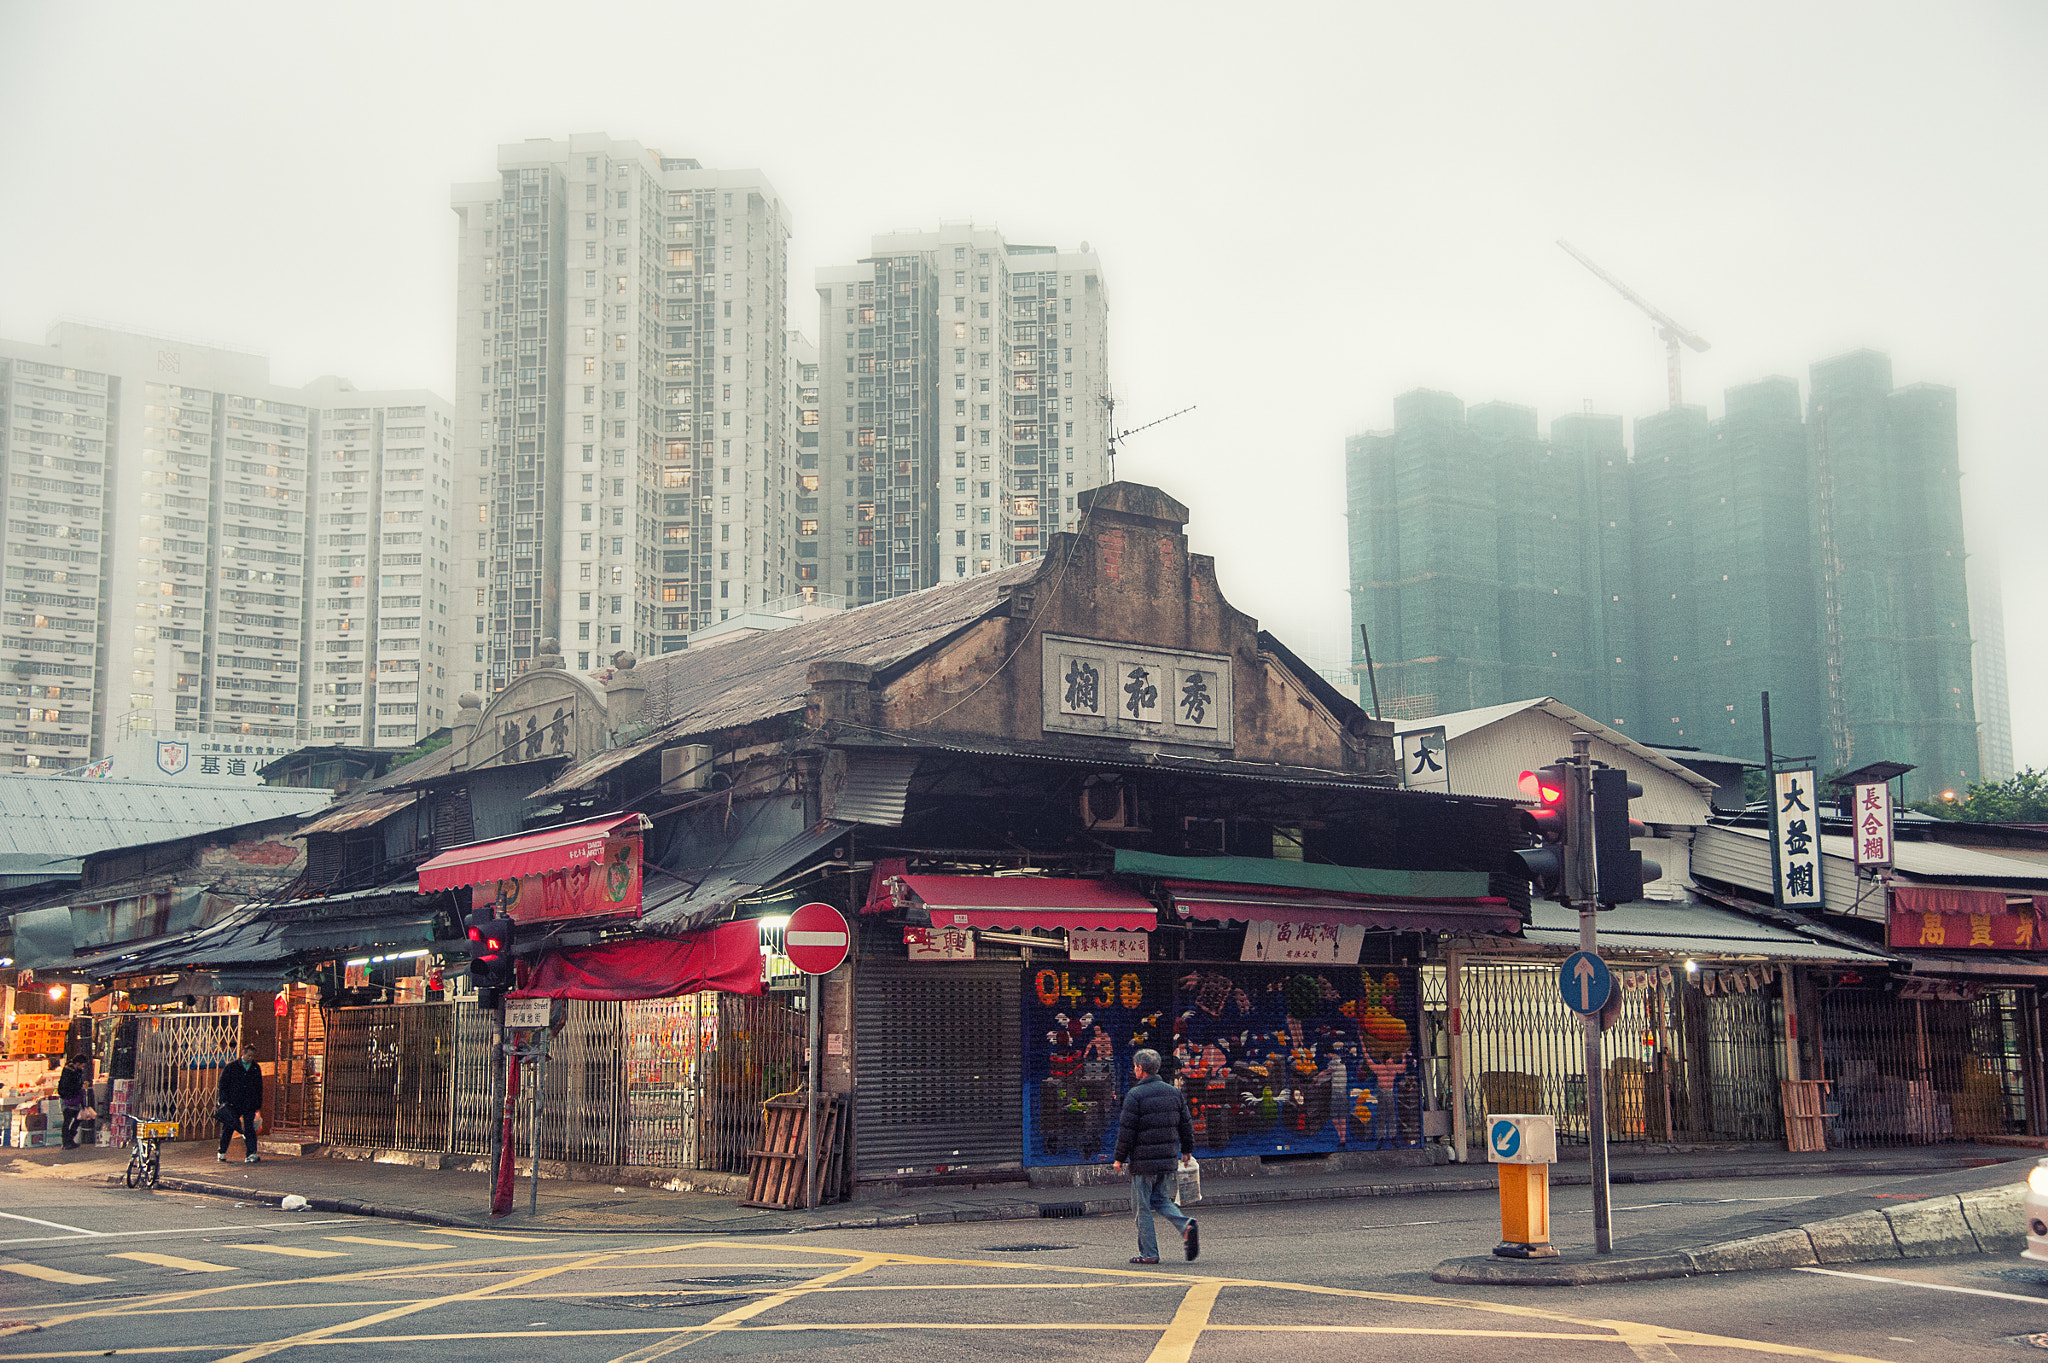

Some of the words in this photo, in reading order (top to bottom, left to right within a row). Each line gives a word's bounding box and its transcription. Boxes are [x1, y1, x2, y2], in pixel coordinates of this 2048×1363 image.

[1861, 787, 1884, 859] 長合欄
[533, 1002, 548, 1010] Street
